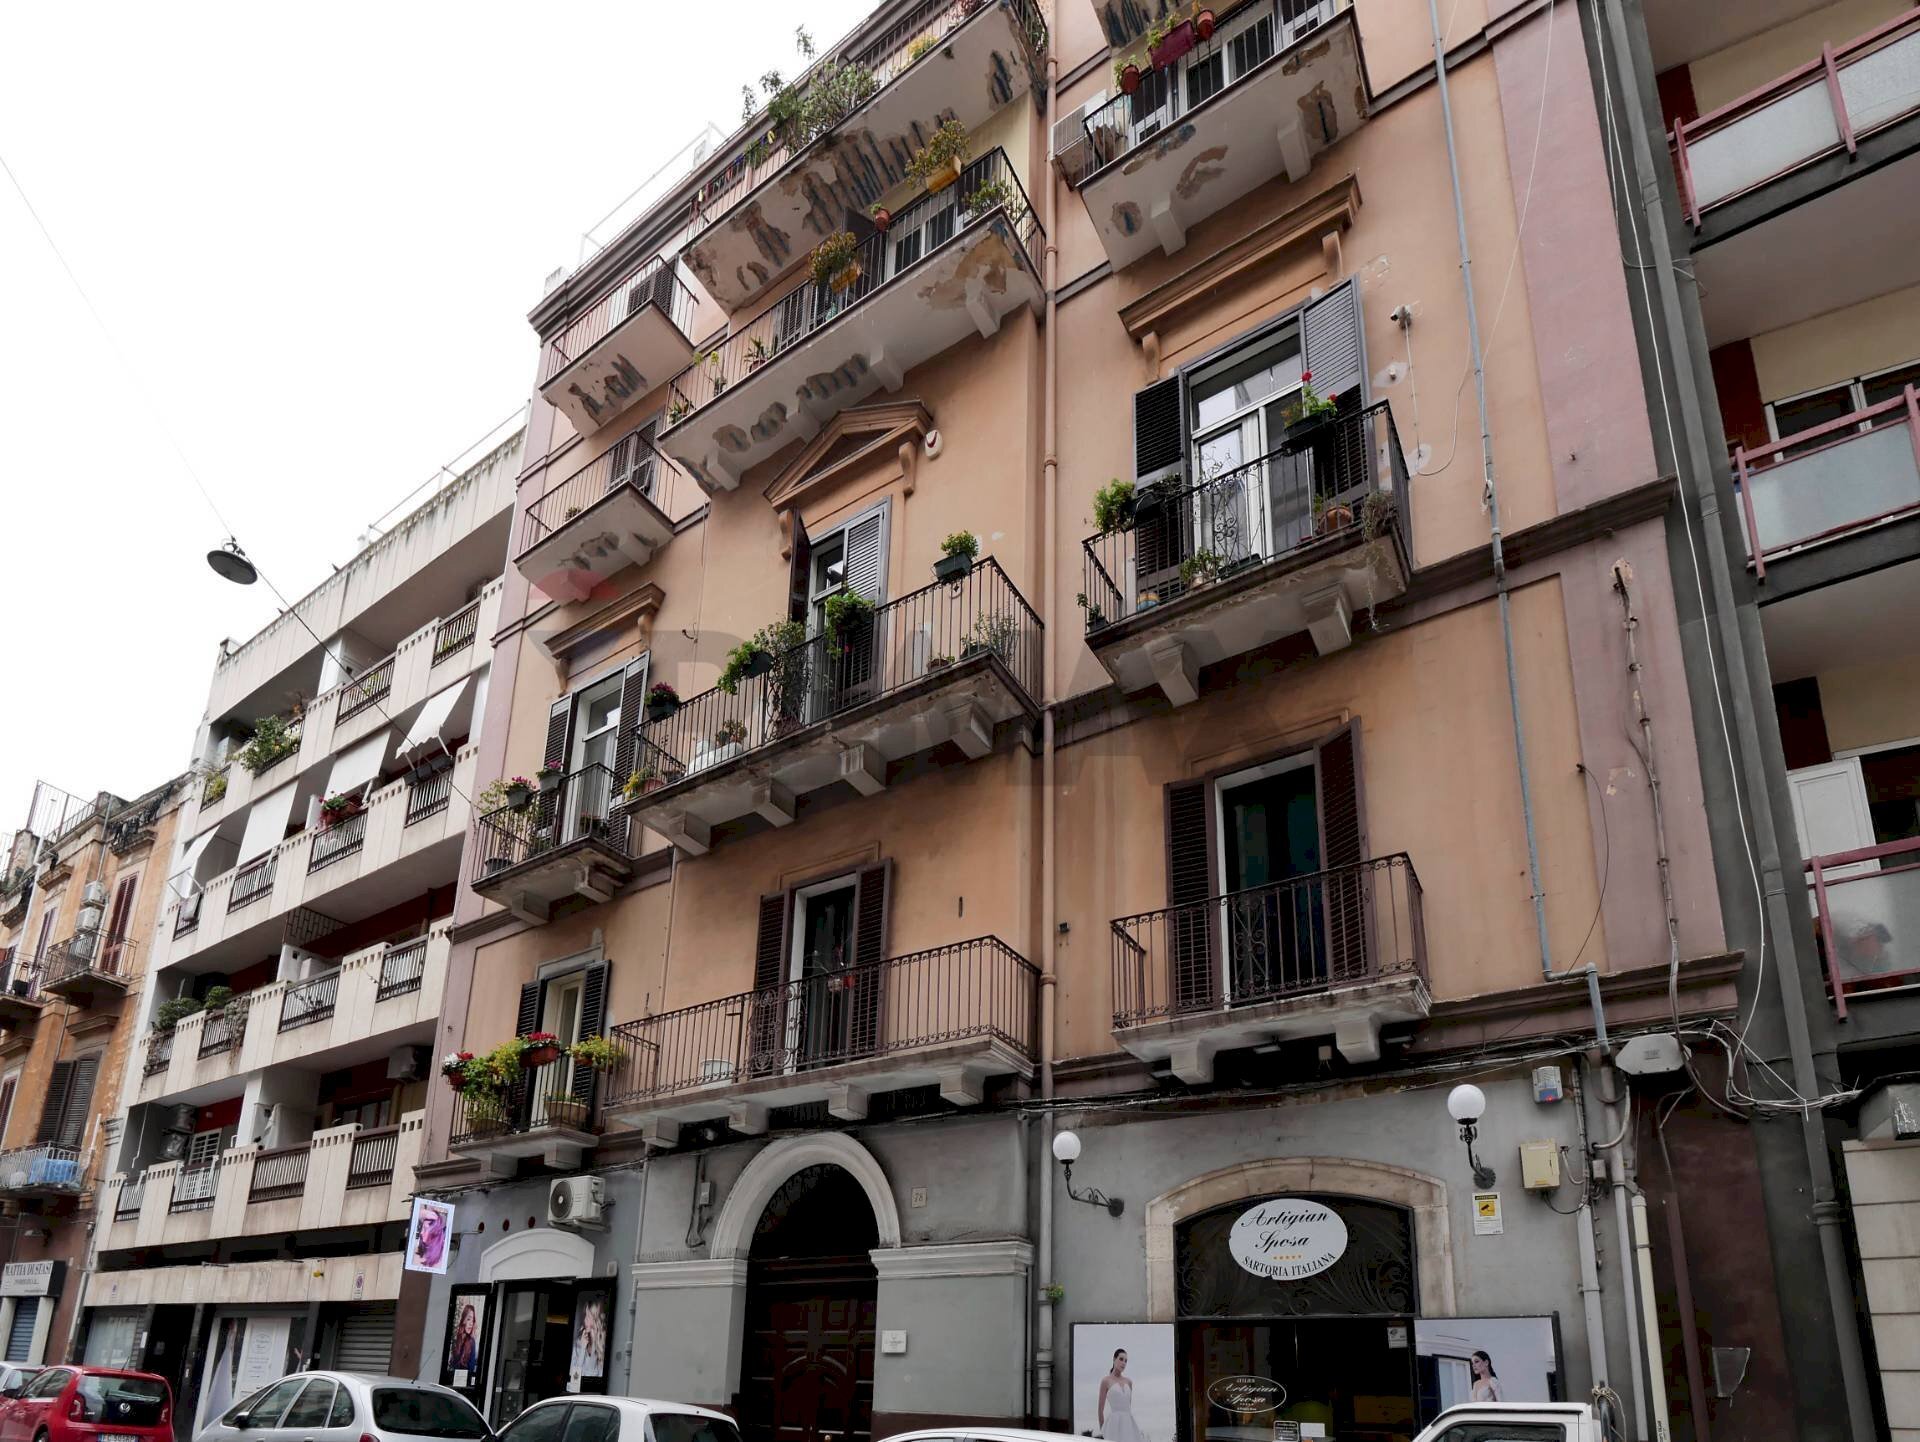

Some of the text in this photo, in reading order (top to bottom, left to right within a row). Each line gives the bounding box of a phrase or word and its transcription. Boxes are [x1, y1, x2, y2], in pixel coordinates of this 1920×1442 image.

[1240, 1208, 1329, 1230] Artigian
[1254, 1230, 1310, 1253] Sposa
[1244, 1251, 1336, 1277] SARTORIA ITALIANA
